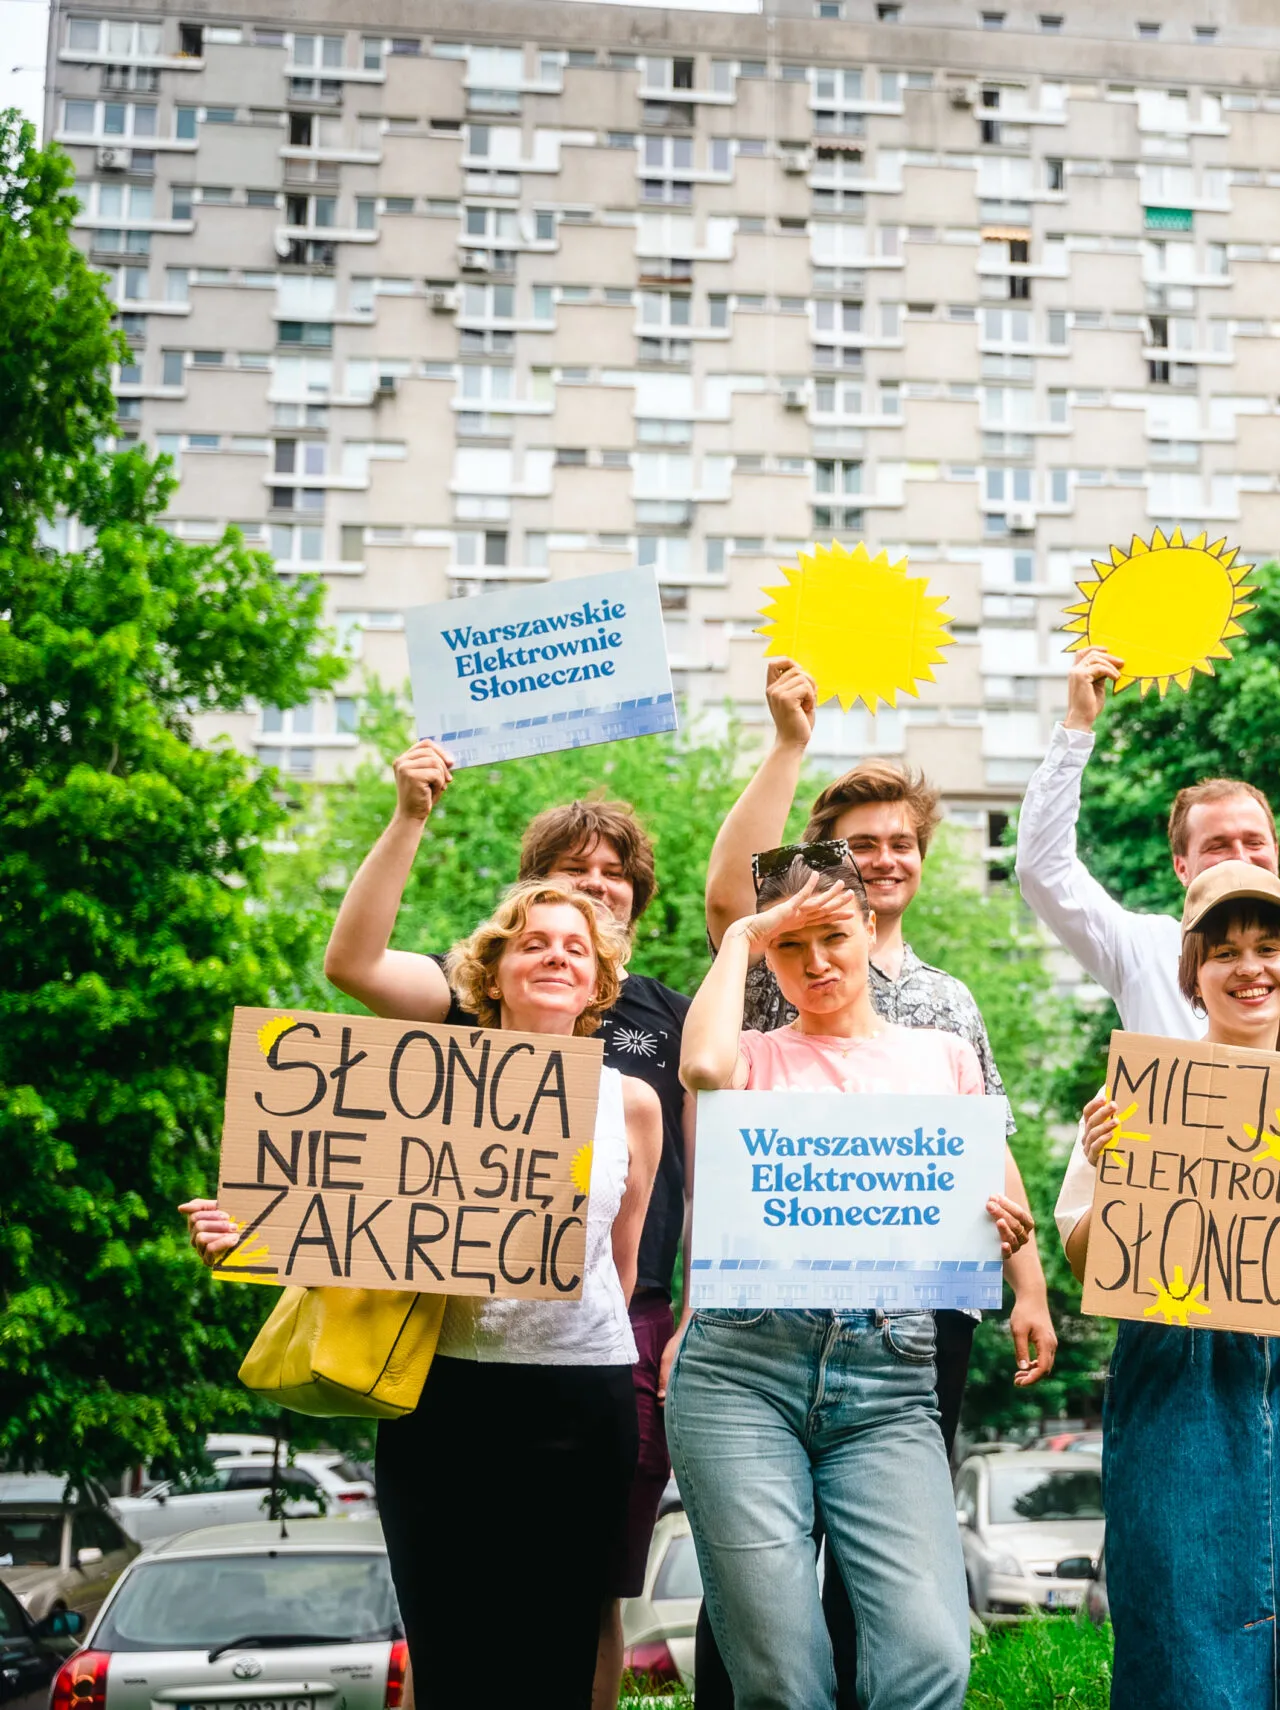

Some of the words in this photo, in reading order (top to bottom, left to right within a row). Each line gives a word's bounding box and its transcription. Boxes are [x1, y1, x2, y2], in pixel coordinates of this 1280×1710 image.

[441, 599, 626, 651] Warszawskie
[455, 627, 623, 678] Elektrownie
[469, 660, 616, 702] Słoneczne
[254, 1022, 570, 1138] SŁOŃCA
[739, 1127, 965, 1157] Warszawskie
[256, 1129, 367, 1190] NIE
[398, 1136, 465, 1200] DA
[473, 1143, 559, 1209] SIĘ
[751, 1162, 955, 1192] Elektrownie
[763, 1196, 941, 1227] Słoneczne
[213, 1181, 587, 1294] ZAKRĘCIĆ
